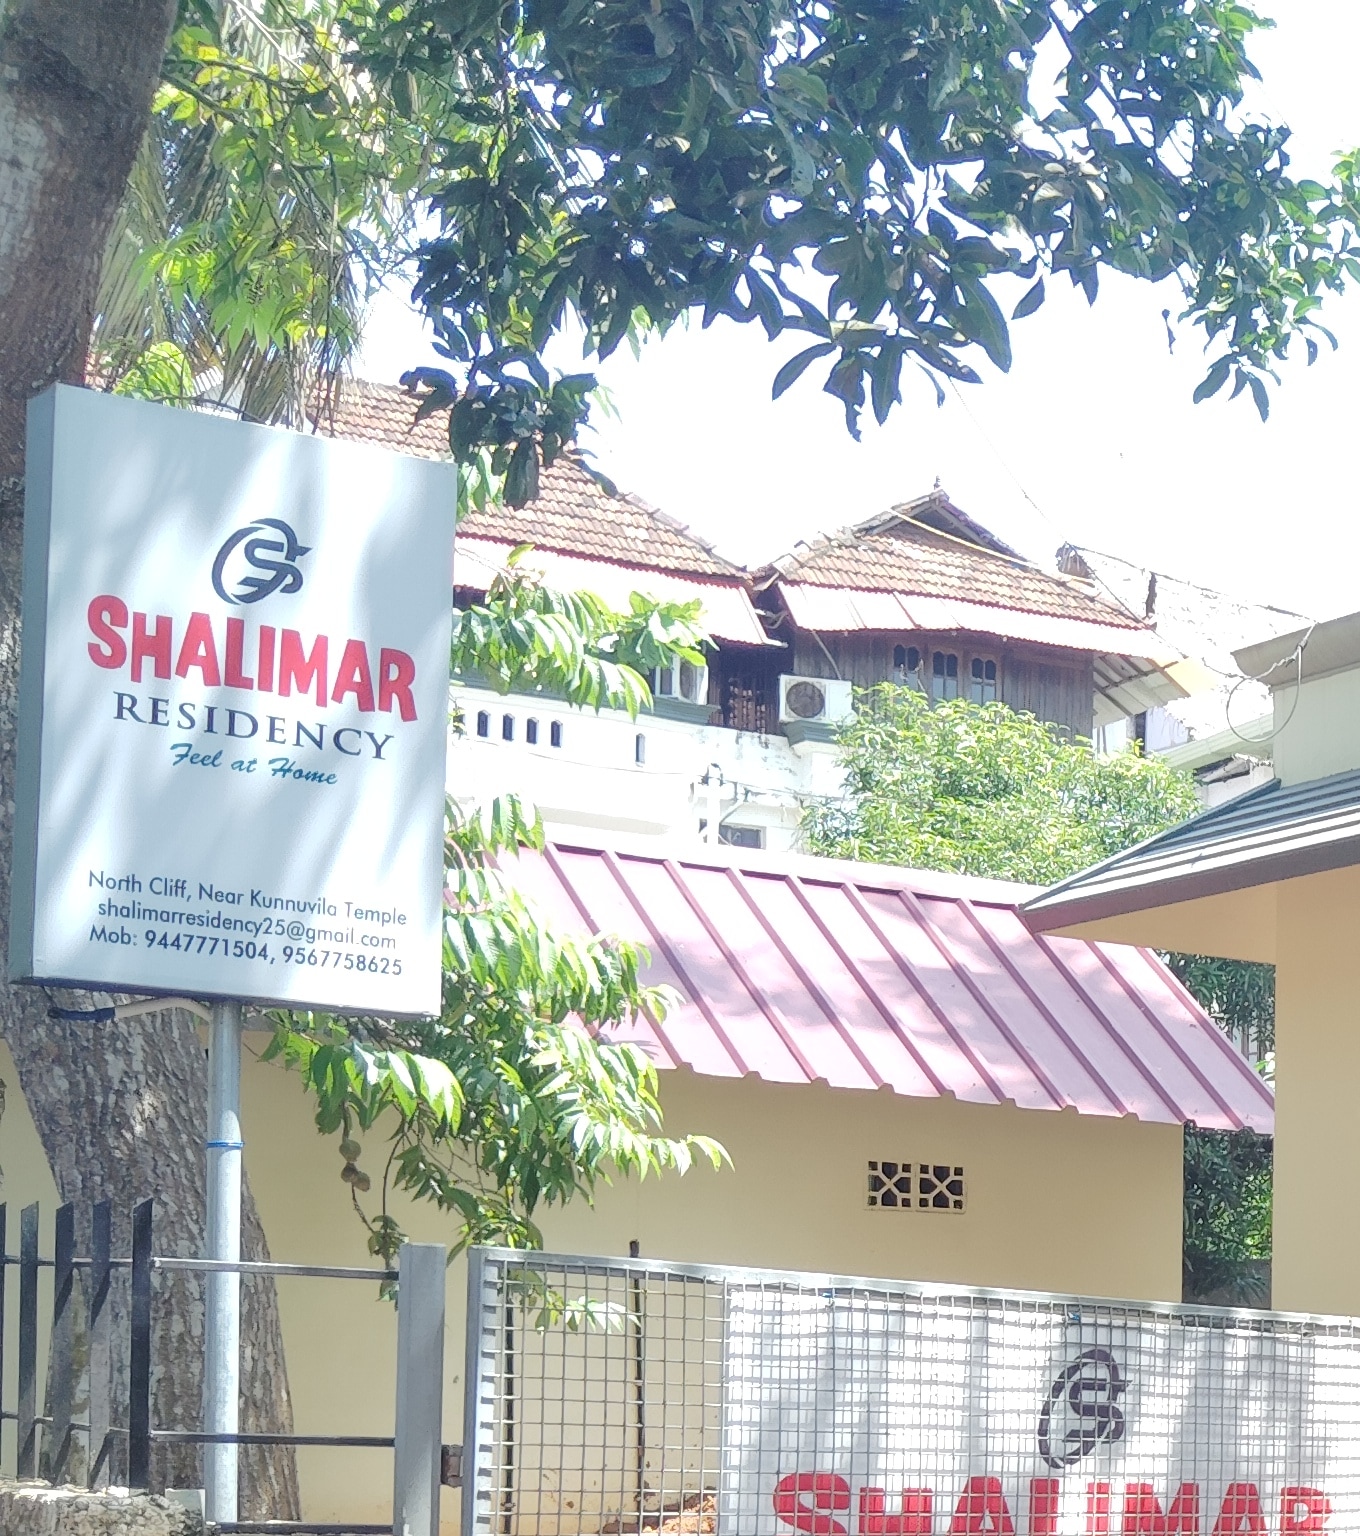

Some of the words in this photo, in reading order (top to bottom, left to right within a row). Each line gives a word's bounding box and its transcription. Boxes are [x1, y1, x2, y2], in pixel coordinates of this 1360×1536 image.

[88, 595, 417, 722] SHALIMAR
[113, 691, 394, 760] RESIDENCY
[170, 743, 222, 766] Feel
[231, 757, 257, 773] at
[268, 758, 338, 785] Home
[88, 870, 142, 893] North
[149, 877, 191, 902] Cliff,
[199, 883, 244, 905] Near
[250, 889, 337, 917] Kunnuvila
[344, 901, 407, 926] Temple
[98, 900, 396, 949] shalimarresidency25@gmail.com
[89, 925, 138, 946] Mob:
[145, 929, 276, 964] 9447771504,
[282, 945, 402, 975] 9567758625
